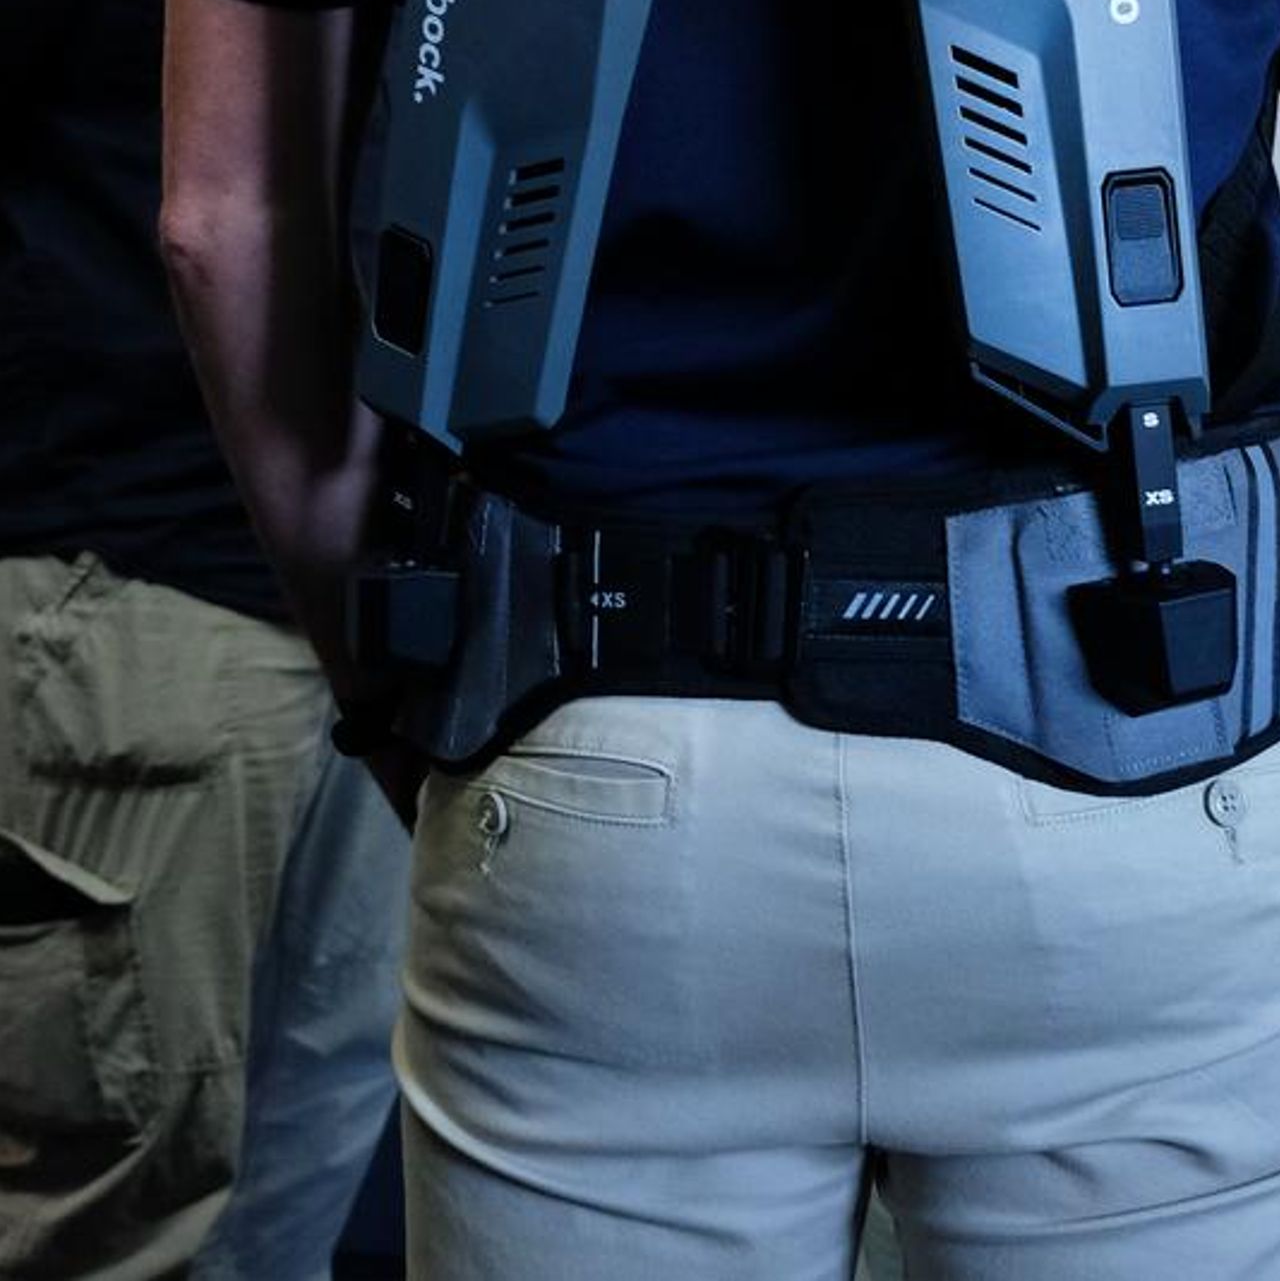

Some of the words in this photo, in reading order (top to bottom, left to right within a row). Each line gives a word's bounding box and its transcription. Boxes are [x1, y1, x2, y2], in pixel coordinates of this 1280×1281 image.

[1143, 411, 1160, 429] S
[1144, 488, 1175, 507] XS
[601, 591, 627, 609] XS
